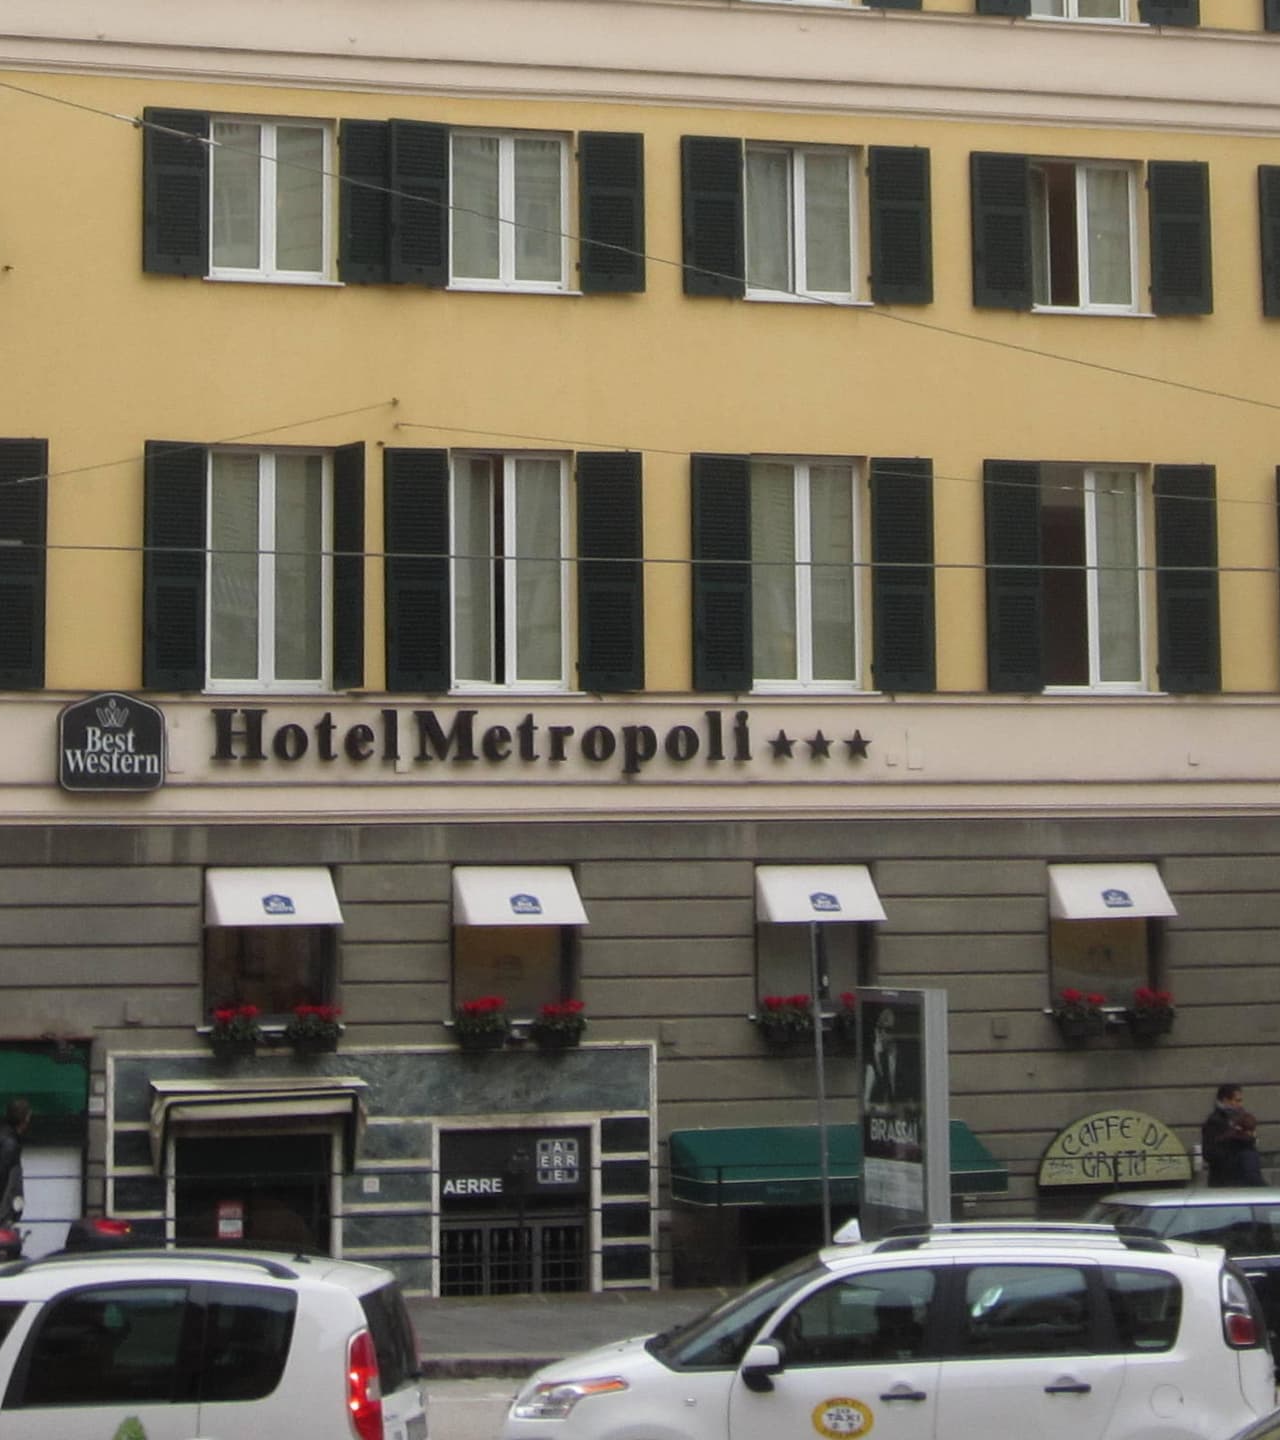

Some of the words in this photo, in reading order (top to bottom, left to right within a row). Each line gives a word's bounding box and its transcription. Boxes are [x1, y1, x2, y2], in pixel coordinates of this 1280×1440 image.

[86, 726, 136, 753] Best
[210, 708, 401, 761] Hotel
[413, 709, 753, 774] Metropoli
[65, 748, 160, 774] Western
[1142, 1122, 1169, 1151] DI
[443, 1177, 503, 1194] AERRE
